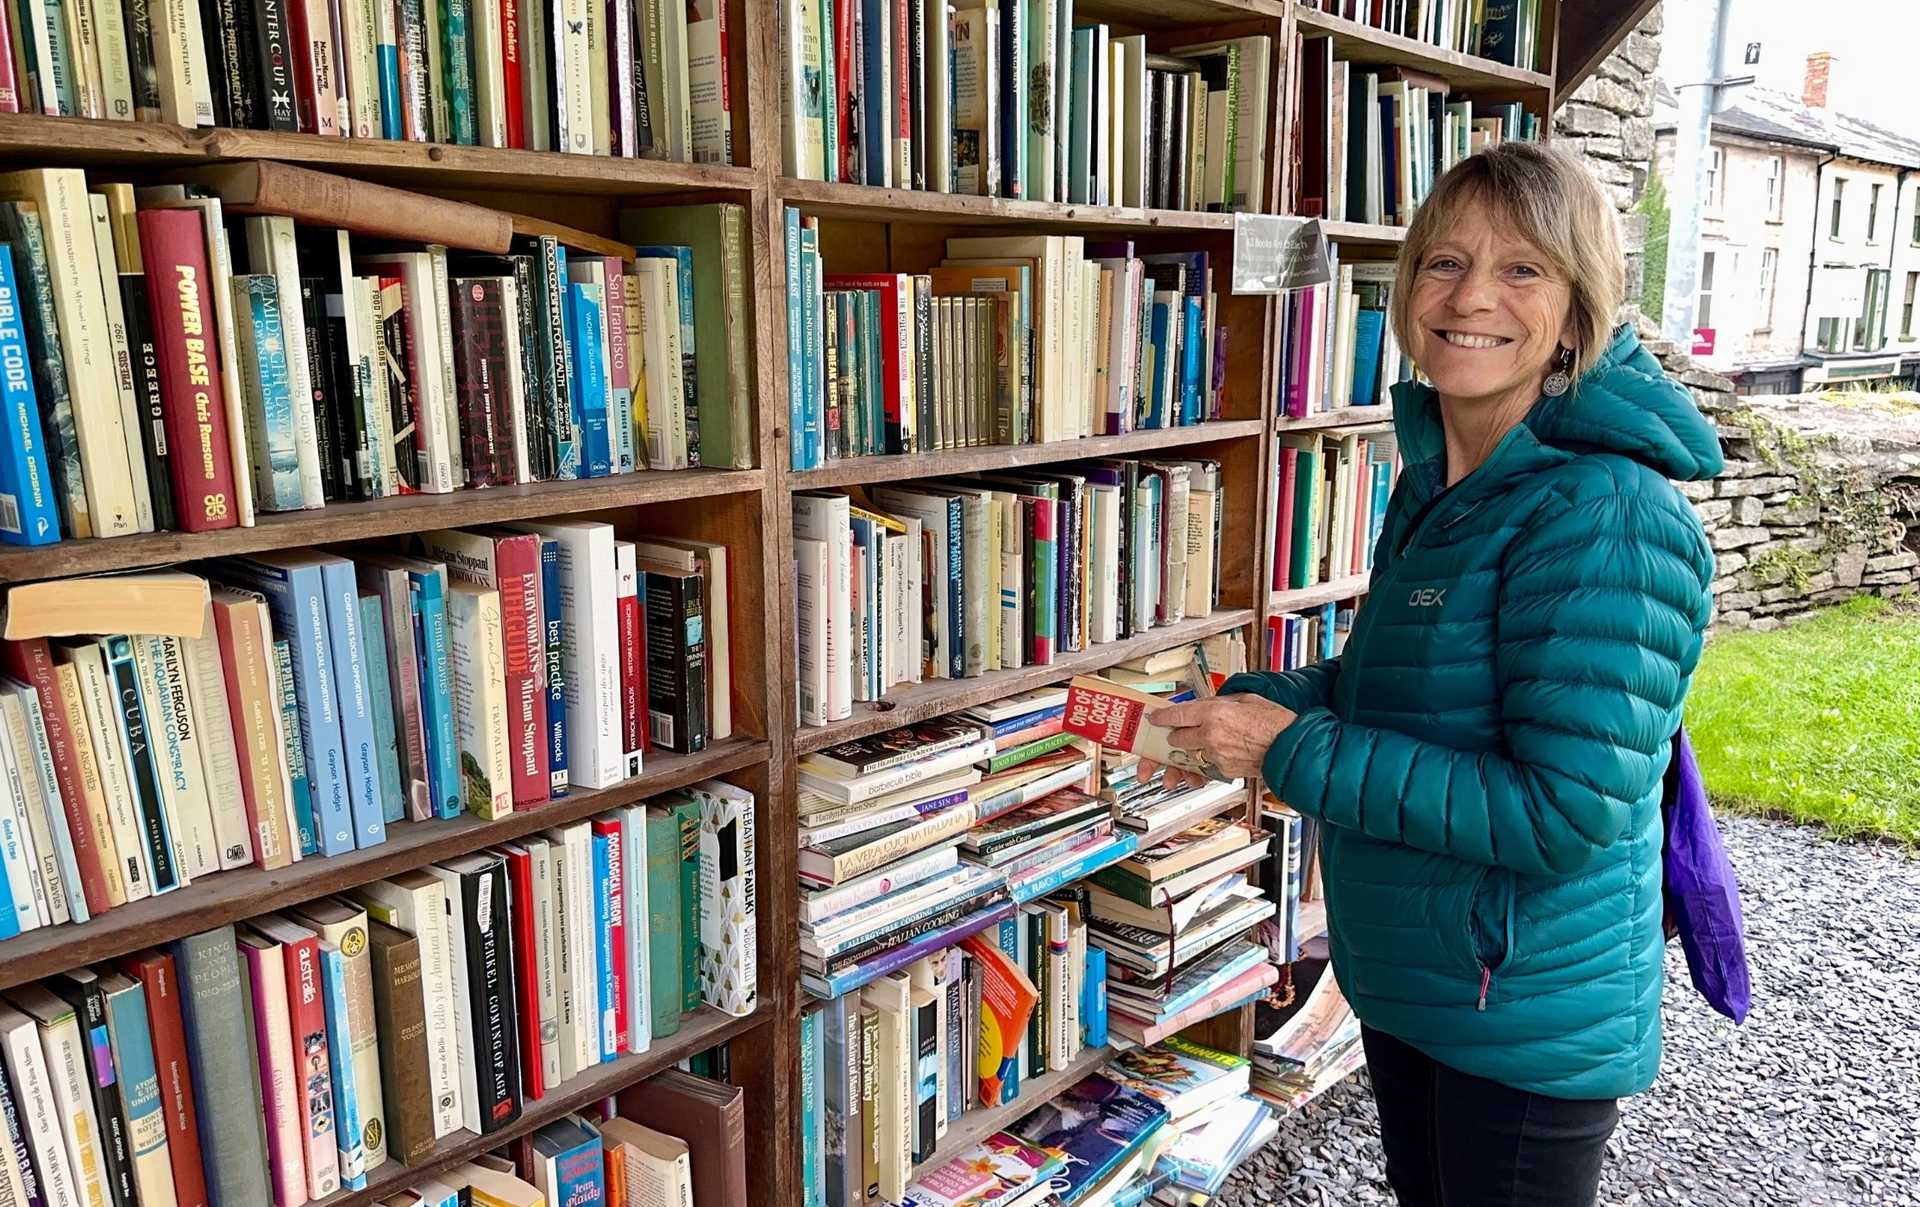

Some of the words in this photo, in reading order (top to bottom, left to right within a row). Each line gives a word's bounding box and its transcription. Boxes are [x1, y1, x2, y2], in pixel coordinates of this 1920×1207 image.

[181, 31, 192, 86] GENTLEMEN
[505, 20, 518, 63] Cookery
[226, 27, 243, 106] PREDICAMENT
[270, 42, 286, 86] COUP
[633, 60, 644, 88] Terry
[271, 108, 291, 118] HAY
[638, 91, 650, 128] Fulton
[546, 241, 557, 272] FOOD
[39, 286, 49, 301] No
[176, 264, 205, 335] POWER
[372, 290, 381, 312] FOOD
[549, 272, 563, 326] COMBINING
[609, 272, 622, 299] San
[805, 262, 813, 310] TEACHING
[114, 322, 125, 344] 1992
[255, 319, 271, 376] GWYNETH
[375, 314, 388, 368] PROCESSORS
[553, 327, 563, 353] FOR
[585, 311, 597, 348] VACHER'S
[612, 304, 627, 370] Francisco
[4, 345, 27, 392] CODE
[118, 350, 132, 390] EPHESUS
[143, 342, 163, 417] GREECE
[185, 338, 210, 386] BASE
[261, 299, 289, 387] MIDNIGHT
[276, 394, 291, 441] LAMP
[555, 353, 566, 387] HEALTH
[588, 349, 598, 388] QUARTERLY
[827, 347, 838, 380] BREAK
[194, 391, 214, 422] Chris
[262, 381, 275, 419] JONES
[686, 382, 694, 399] 2019
[829, 381, 838, 408] NECK
[921, 377, 929, 415] HOFFMAN
[16, 401, 34, 453] MICHAEL
[25, 456, 42, 508] DROSNIN
[201, 424, 217, 481] Ransome
[949, 502, 959, 544] FARLEY
[456, 550, 489, 571] Stoppard
[951, 545, 960, 581] MOWAT
[343, 592, 357, 637] CORPORATE
[1408, 588, 1447, 607] OEX
[309, 596, 323, 641] CORPORATE
[502, 574, 527, 676] LIFEGUIDE
[522, 572, 541, 673] EVERYWOMAN'S
[548, 619, 563, 648] best
[33, 647, 46, 666] The
[279, 643, 290, 664] THE
[315, 640, 327, 668] SOCIAL
[349, 637, 361, 664] SOCIAL
[34, 666, 51, 684] Life
[281, 663, 293, 688] PAIN
[437, 655, 450, 696] Davies
[545, 651, 565, 701] practice
[31, 702, 40, 715] THE
[41, 685, 57, 709] Story
[67, 701, 81, 725] WITH
[171, 683, 192, 742] FERGUSON
[520, 679, 536, 721] Miriam
[627, 686, 637, 719] PELLOUX
[1074, 688, 1093, 705] of
[1087, 693, 1111, 725] God's
[33, 715, 43, 732] PIED
[121, 687, 146, 757] CUBA
[152, 660, 173, 722] AQUARIAN
[164, 723, 187, 792] CONSPIRACY
[1068, 704, 1089, 727] One
[1101, 697, 1130, 746] smallest
[36, 732, 47, 752] PIPER
[73, 727, 86, 748] ONE
[491, 704, 505, 782] TREVALLION
[522, 722, 539, 777] Stoppard
[552, 720, 564, 762] Willcocks
[628, 721, 637, 750] PATRICK
[78, 749, 98, 793] ANOTHER
[327, 748, 339, 780] Grayson
[360, 742, 371, 774] Grayson
[43, 762, 57, 794] HAMELIN
[364, 776, 375, 806] Hodges
[867, 776, 904, 795] barbecue
[904, 767, 923, 783] bible
[332, 782, 343, 813] Hodges
[815, 810, 840, 823] Hamlyn
[839, 803, 863, 817] Kitchen
[921, 802, 938, 813] JANE
[150, 817, 160, 850] ANDREW
[839, 857, 855, 870] LA
[857, 847, 883, 864] VERA
[883, 830, 922, 851] CUCINA
[922, 812, 966, 835] ITALIANA
[43, 854, 56, 875] Len
[607, 831, 621, 894] SOCIOLOGICAL
[48, 877, 65, 909] Davies
[555, 877, 565, 914] programming
[602, 877, 611, 920] Marketing
[610, 894, 622, 928] THEORY
[603, 920, 613, 970] Management
[846, 922, 901, 948] ALLERGY-FREE
[900, 908, 934, 927] COOKING
[887, 926, 923, 948] ITALIAN
[922, 909, 960, 934] COOKING
[196, 941, 232, 961] KING
[483, 924, 498, 989] TERKEL
[299, 946, 316, 1005] australia
[487, 995, 503, 1049] COMING
[847, 1012, 857, 1028] The
[492, 1050, 505, 1068] OF
[847, 1028, 858, 1064] Making
[862, 1025, 873, 1066] Country
[495, 1072, 507, 1100] AGE
[848, 1075, 859, 1117] Mankind
[862, 1066, 874, 1102] Pottery
[20, 1170, 38, 1200] Miller
[566, 1188, 601, 1207] Plaidy
[572, 1179, 595, 1197] Jean
